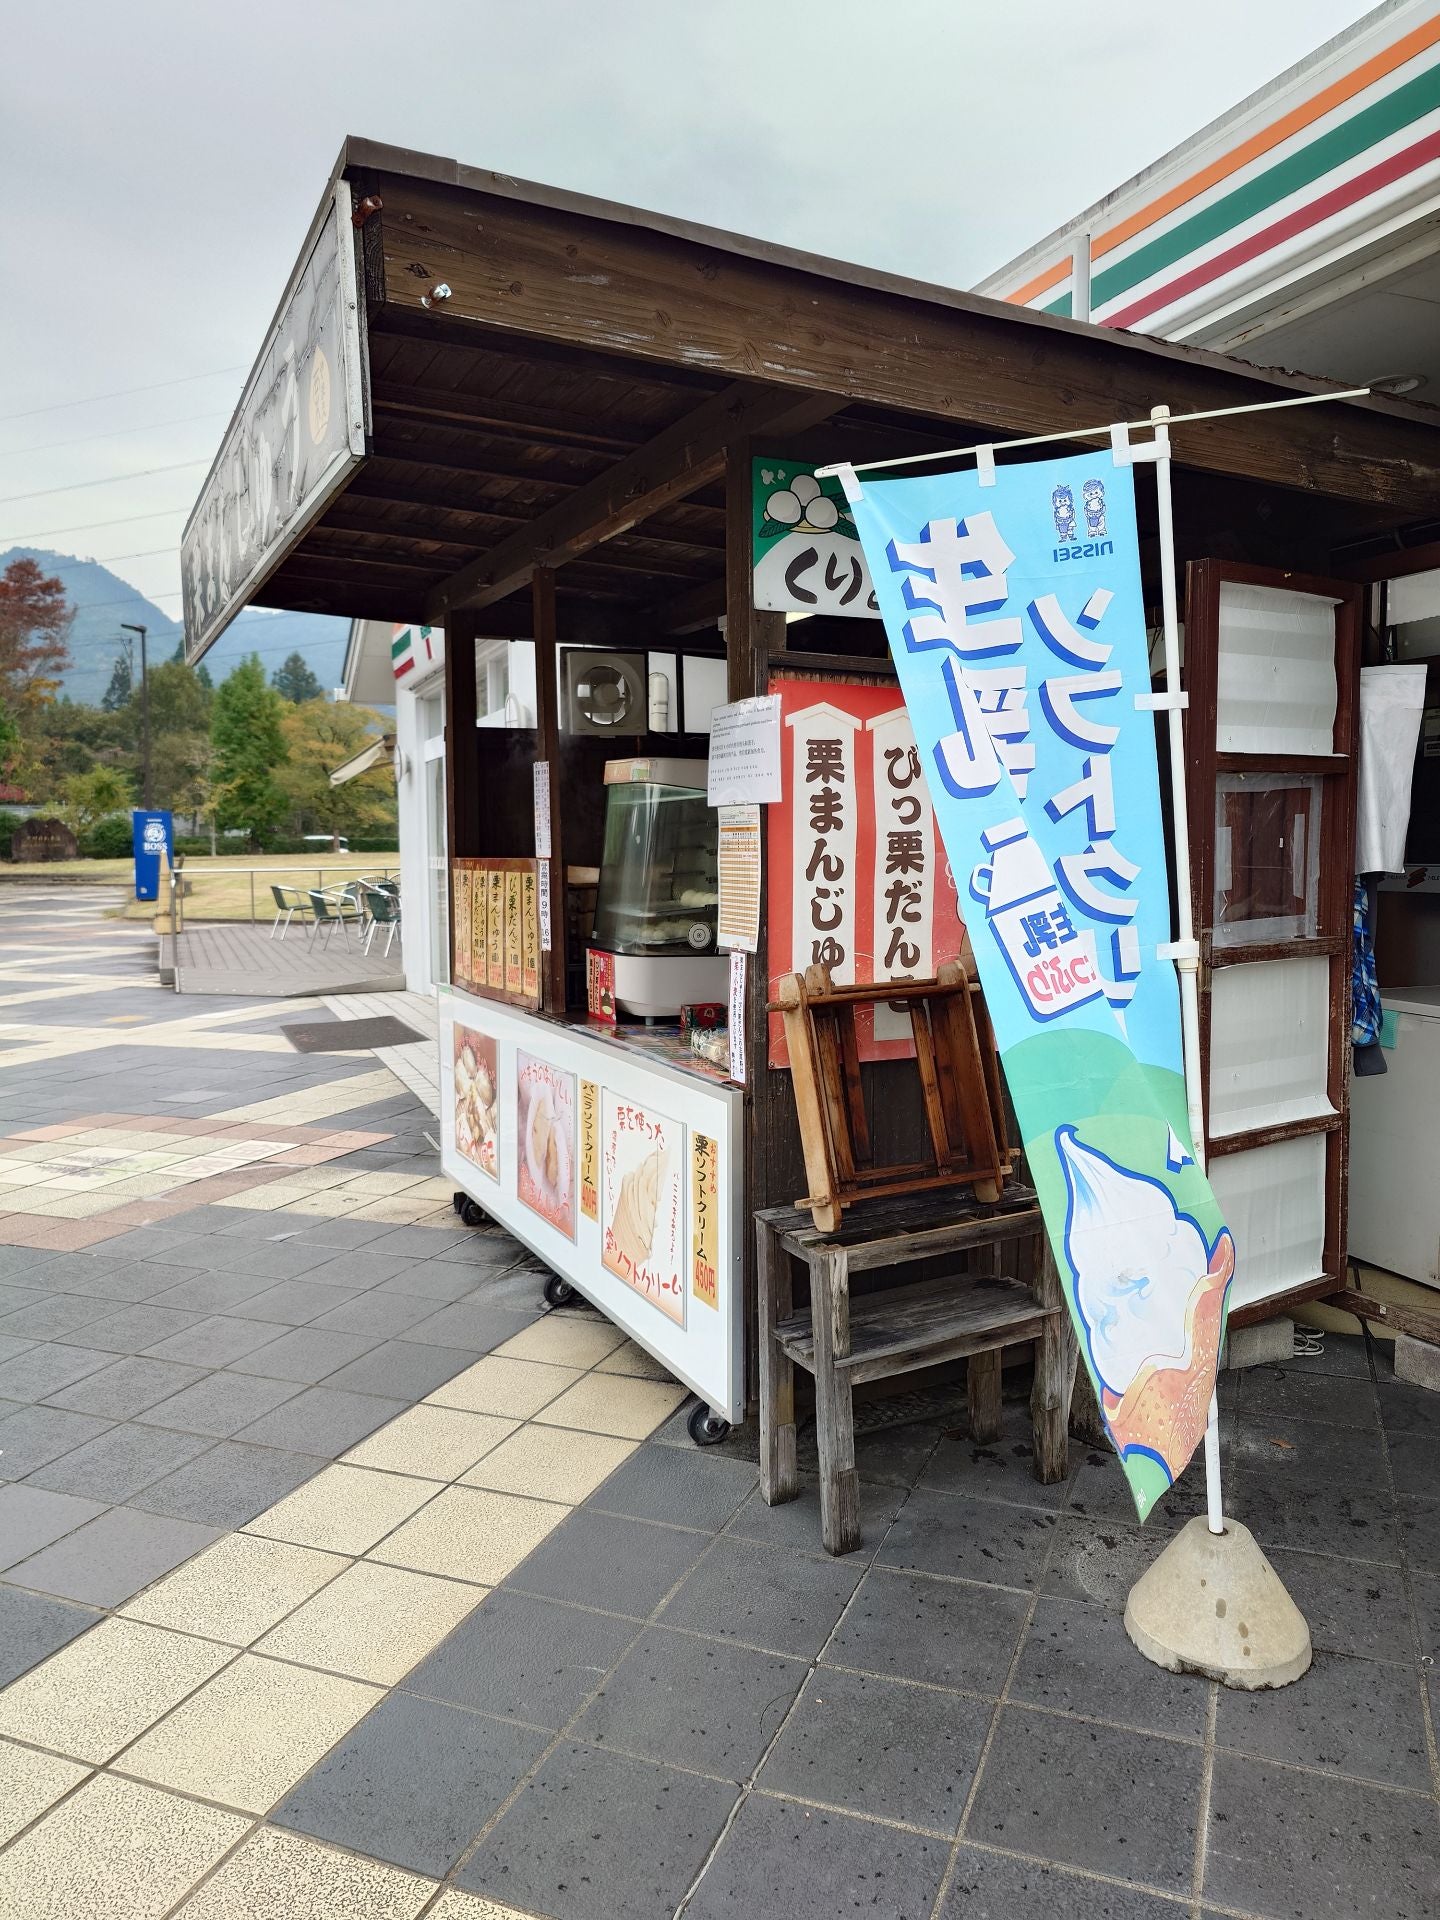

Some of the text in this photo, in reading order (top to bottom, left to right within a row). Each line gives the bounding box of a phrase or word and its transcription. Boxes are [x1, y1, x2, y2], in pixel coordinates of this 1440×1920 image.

[144, 842, 168, 851] BOSS
[540, 862, 549, 897] 営業時間
[805, 738, 847, 975] 栗まんじゅ
[491, 873, 502, 951] 栗まんじゅう
[525, 876, 535, 955] 栗まんじゅう
[694, 1134, 716, 1299] 栗ソフトクリーム 450円
